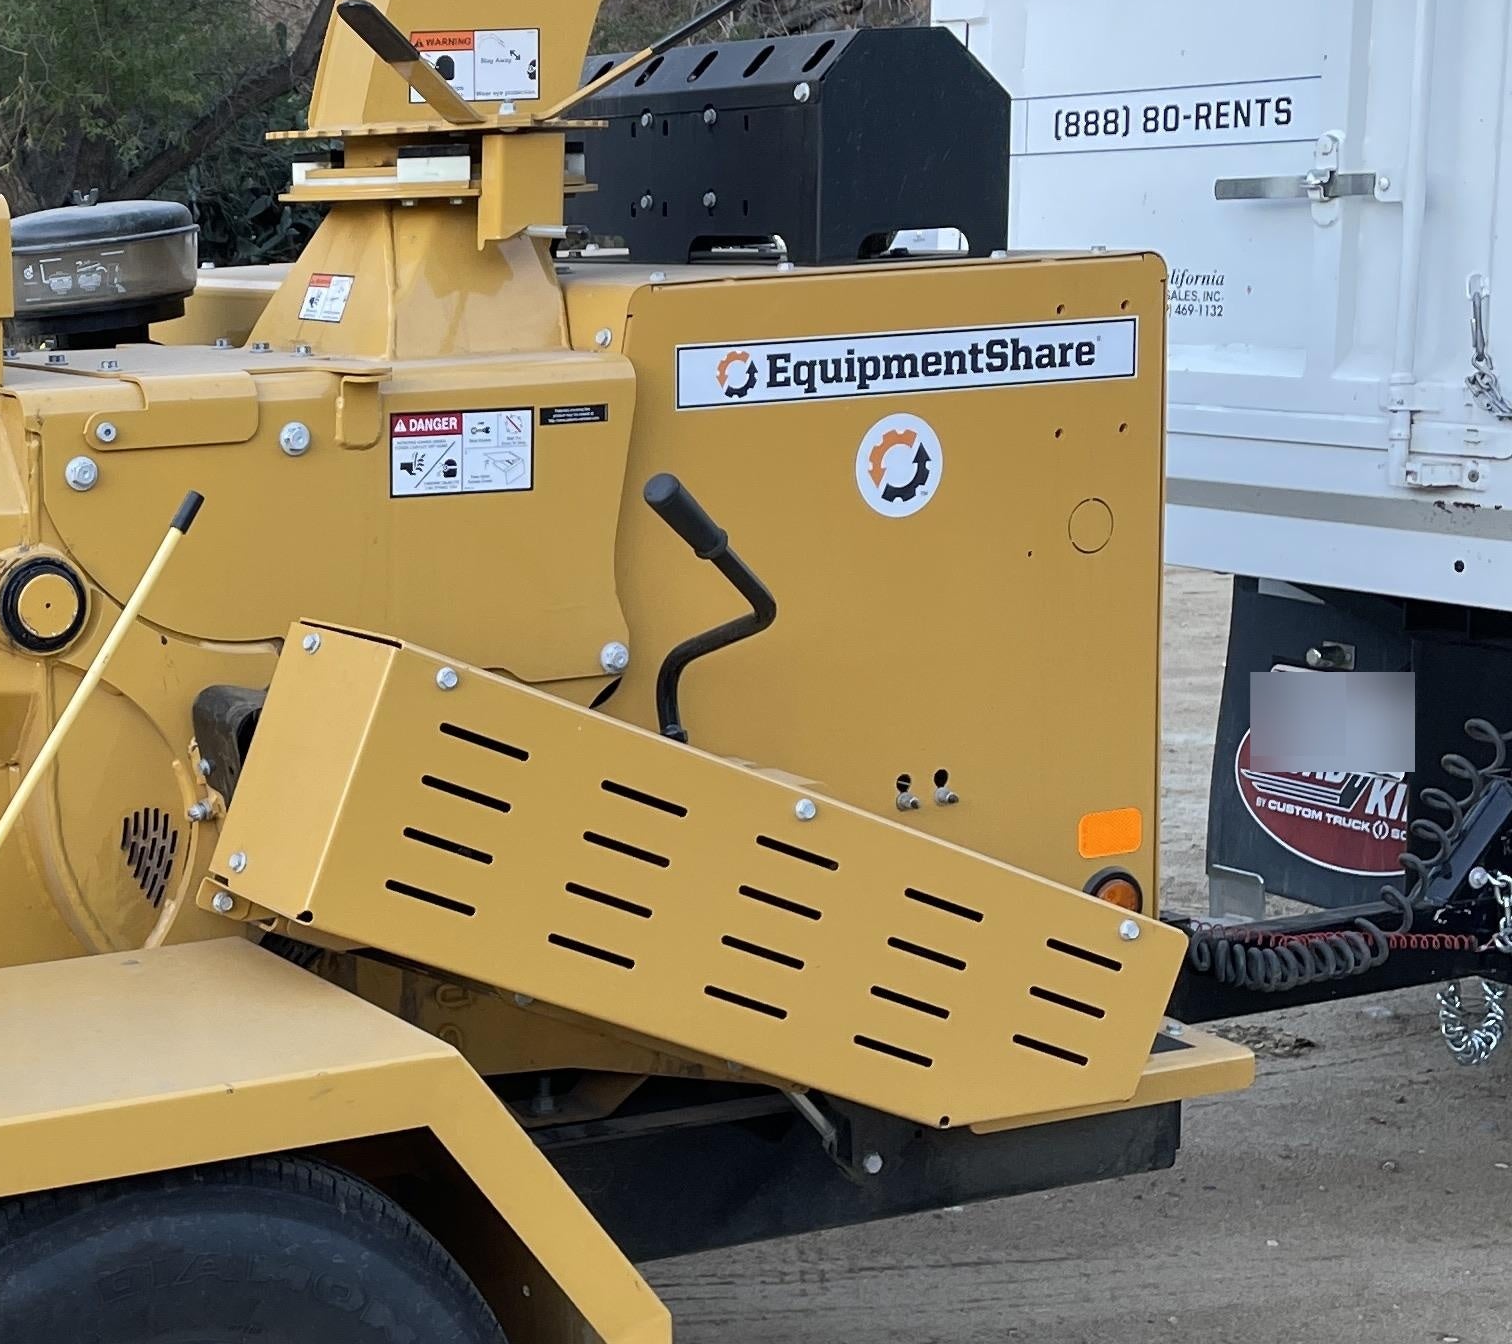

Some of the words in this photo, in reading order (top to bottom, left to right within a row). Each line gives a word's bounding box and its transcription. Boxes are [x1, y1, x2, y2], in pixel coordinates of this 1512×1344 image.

[426, 37, 471, 46] WARNING
[1054, 105, 1130, 140] (888)
[1143, 97, 1292, 133] 80-RENTS
[1169, 268, 1224, 288] lifornia
[1203, 290, 1224, 301] INC.
[1175, 304, 1223, 316] 469-1132
[767, 338, 1096, 393] EquipmentShare
[409, 417, 458, 432] DANGER
[1268, 799, 1323, 821] CUSTOM
[1325, 812, 1370, 832] TRUCK
